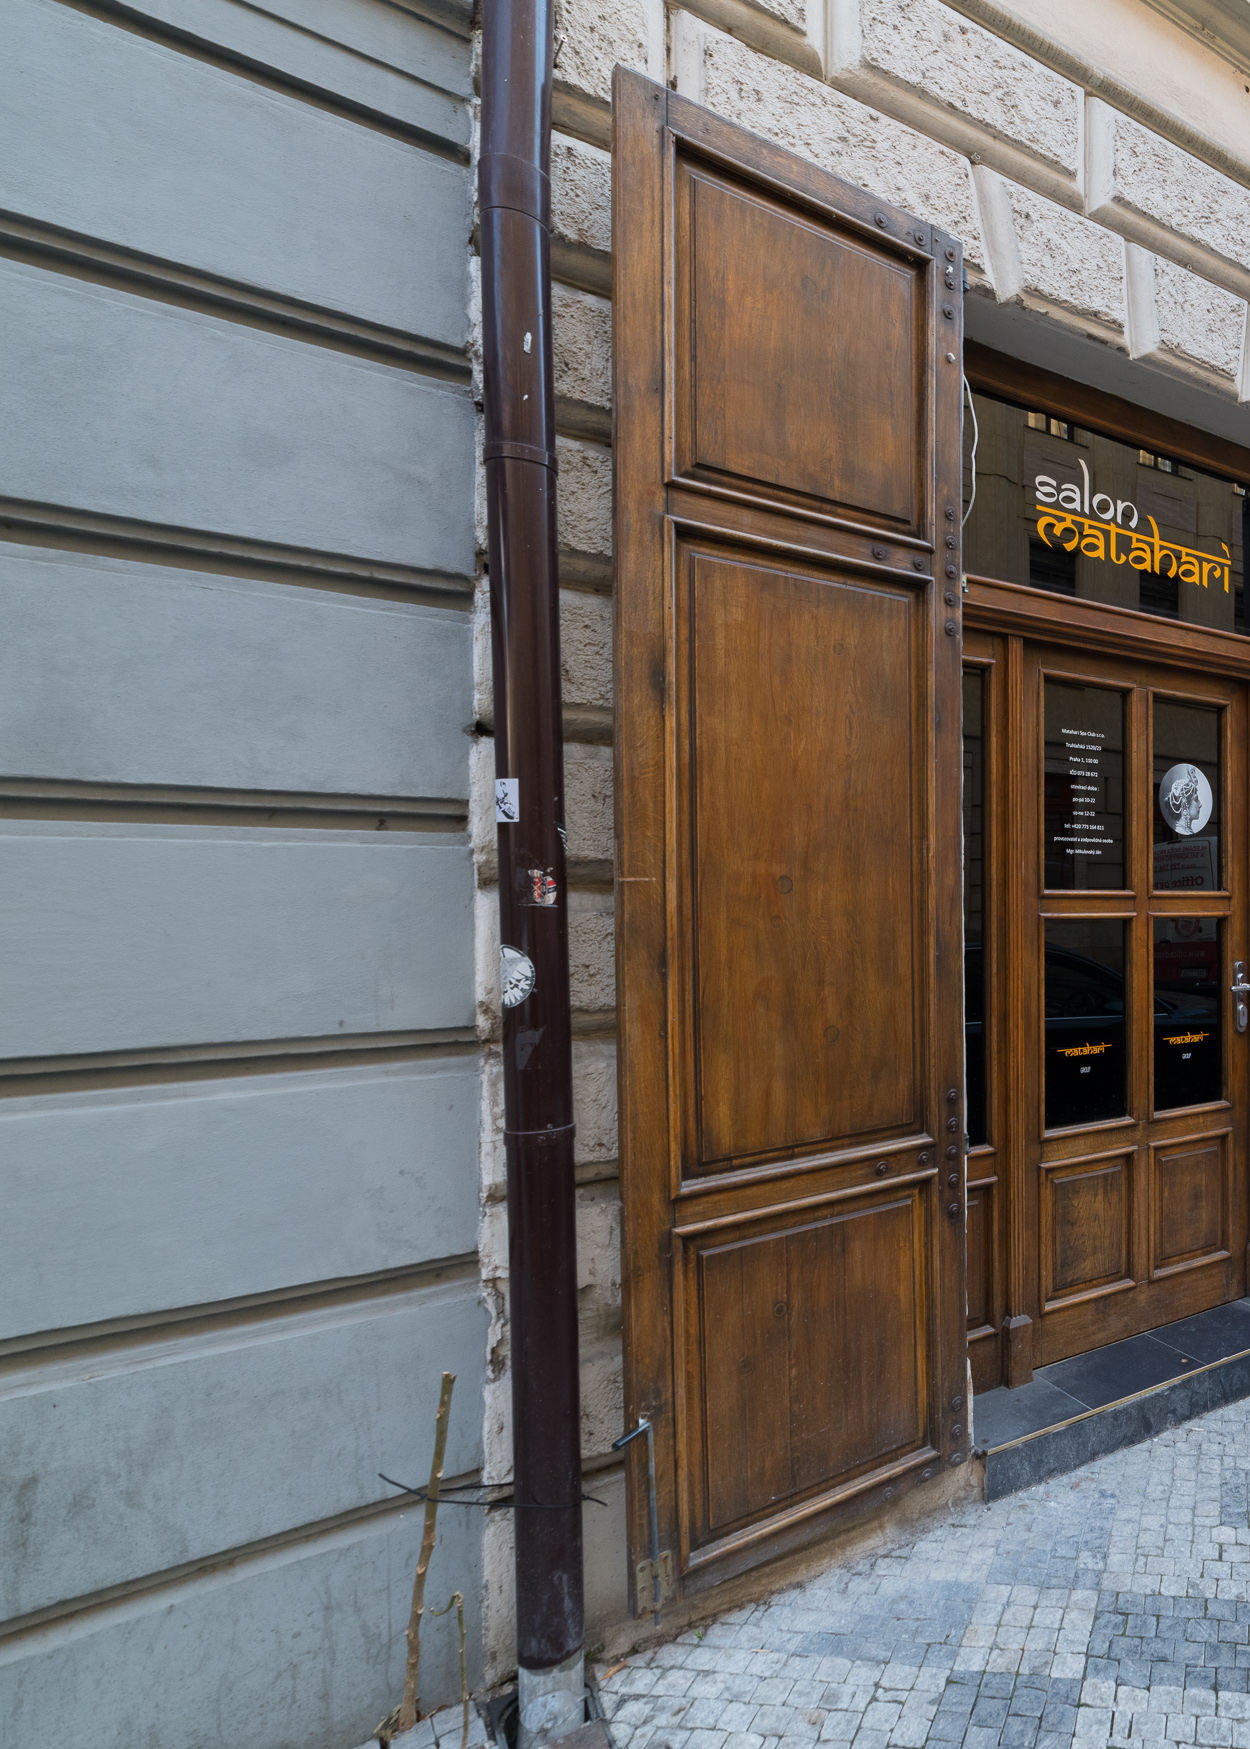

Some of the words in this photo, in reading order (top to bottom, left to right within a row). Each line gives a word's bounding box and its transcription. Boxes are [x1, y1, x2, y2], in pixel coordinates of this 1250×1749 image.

[1034, 458, 1139, 529] salon
[1036, 505, 1232, 594] matahari
[1061, 728, 1080, 736] Matahari
[1163, 1031, 1209, 1045] matahari
[1057, 1042, 1112, 1057] matahari
